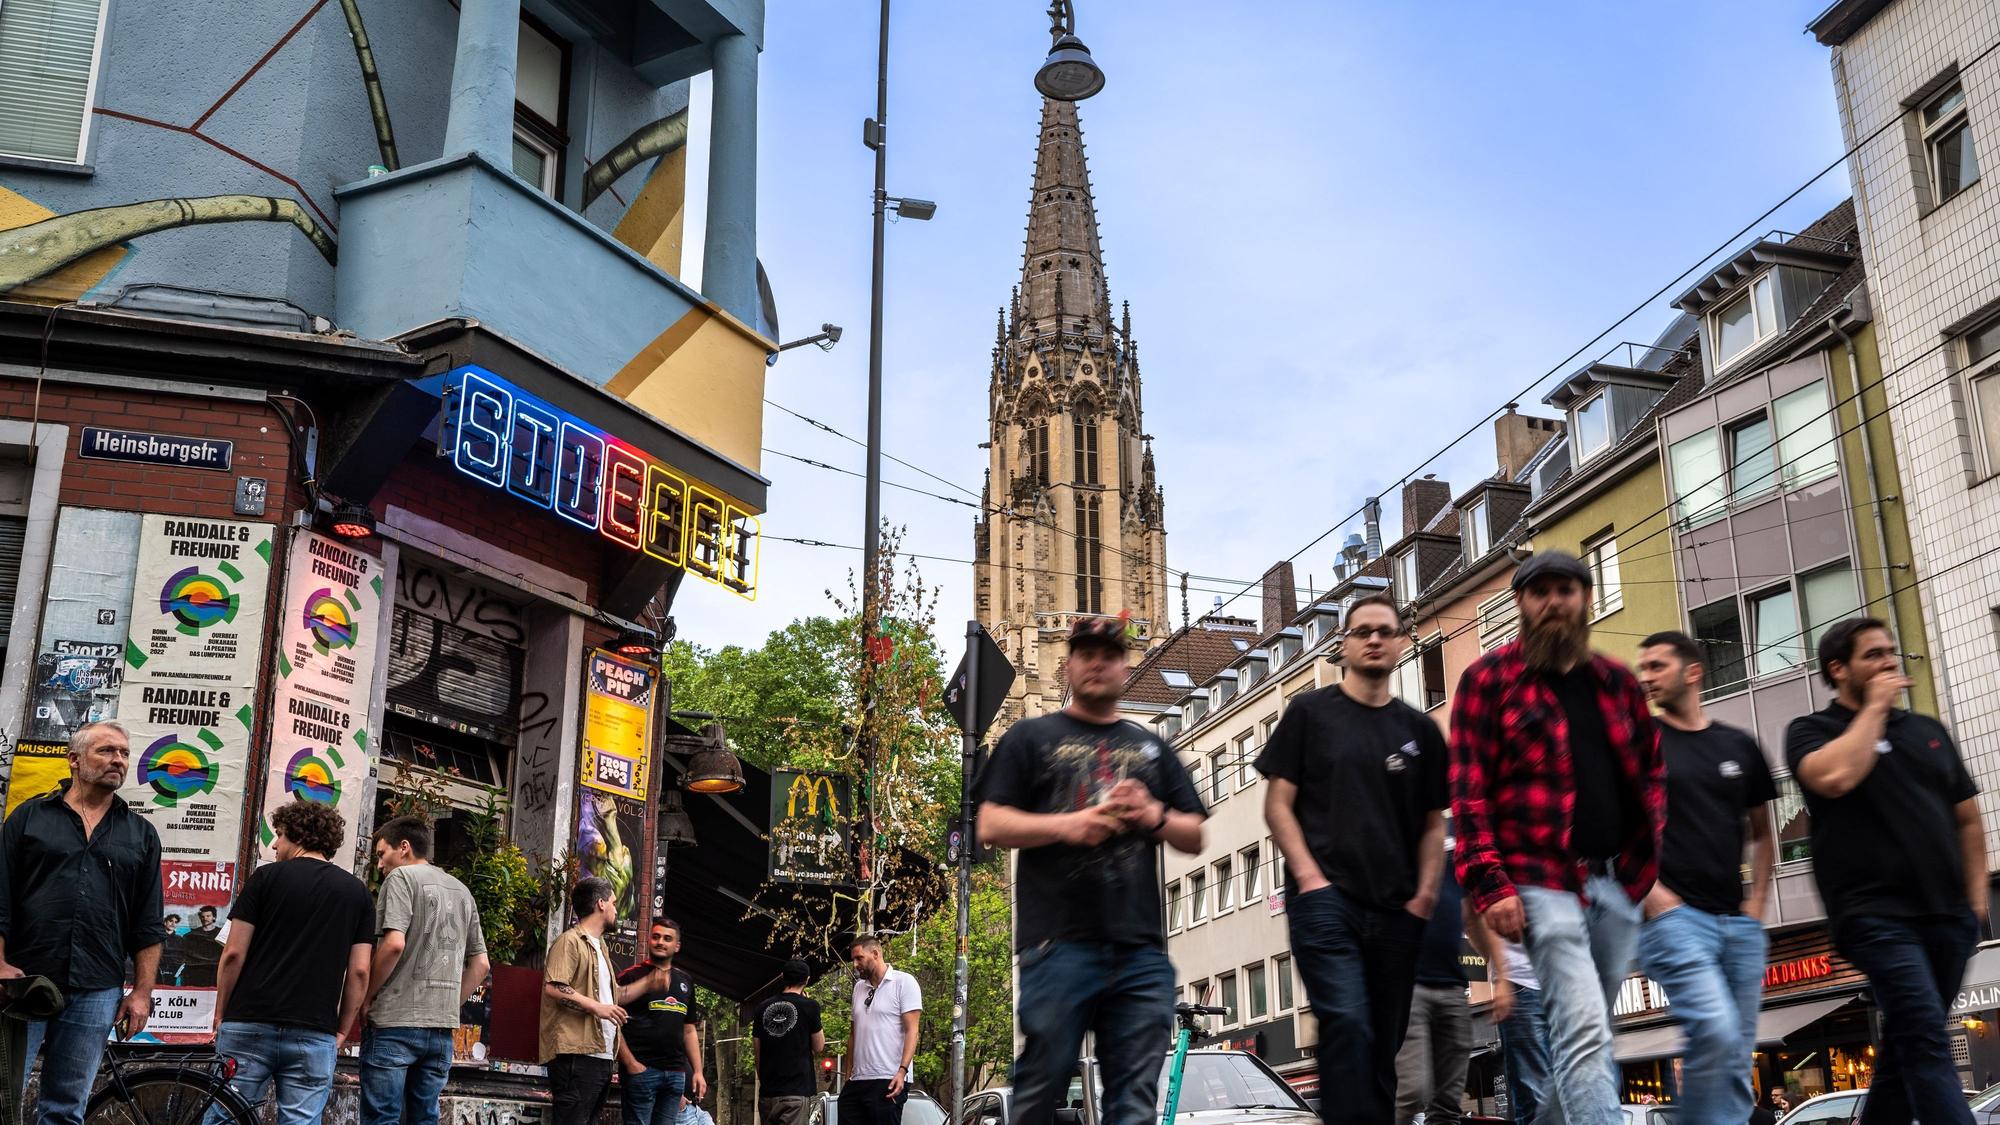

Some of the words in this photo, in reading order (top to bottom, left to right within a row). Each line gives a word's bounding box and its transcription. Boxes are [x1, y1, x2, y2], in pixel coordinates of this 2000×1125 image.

[94, 431, 218, 463] Heinsbergstr.
[163, 520, 236, 541] RANDALE
[238, 526, 250, 542] &
[170, 540, 240, 560] FREUNDE
[308, 538, 359, 571] RANDALE
[359, 558, 368, 574] &
[311, 558, 360, 590] FREUNDE
[200, 651, 236, 659] LUMPENPACK
[596, 659, 645, 687] PEACH
[606, 677, 631, 697] PIT
[142, 687, 217, 707] RANDALE
[218, 691, 231, 708] &
[148, 707, 220, 727] FREUNDE
[288, 697, 340, 727] RANDALE
[341, 712, 350, 729] &
[292, 718, 343, 746] FREUNDE
[17, 743, 68, 755] MUSCHE
[600, 755, 628, 772] FROM
[189, 817, 215, 825] PEGATINA
[161, 847, 210, 855] LEUNDFREUNDE.DE
[167, 870, 231, 892] SPRING
[1781, 955, 1829, 983] DRINKS
[168, 995, 198, 1007] KÖLN
[159, 1010, 183, 1019] CLUB
